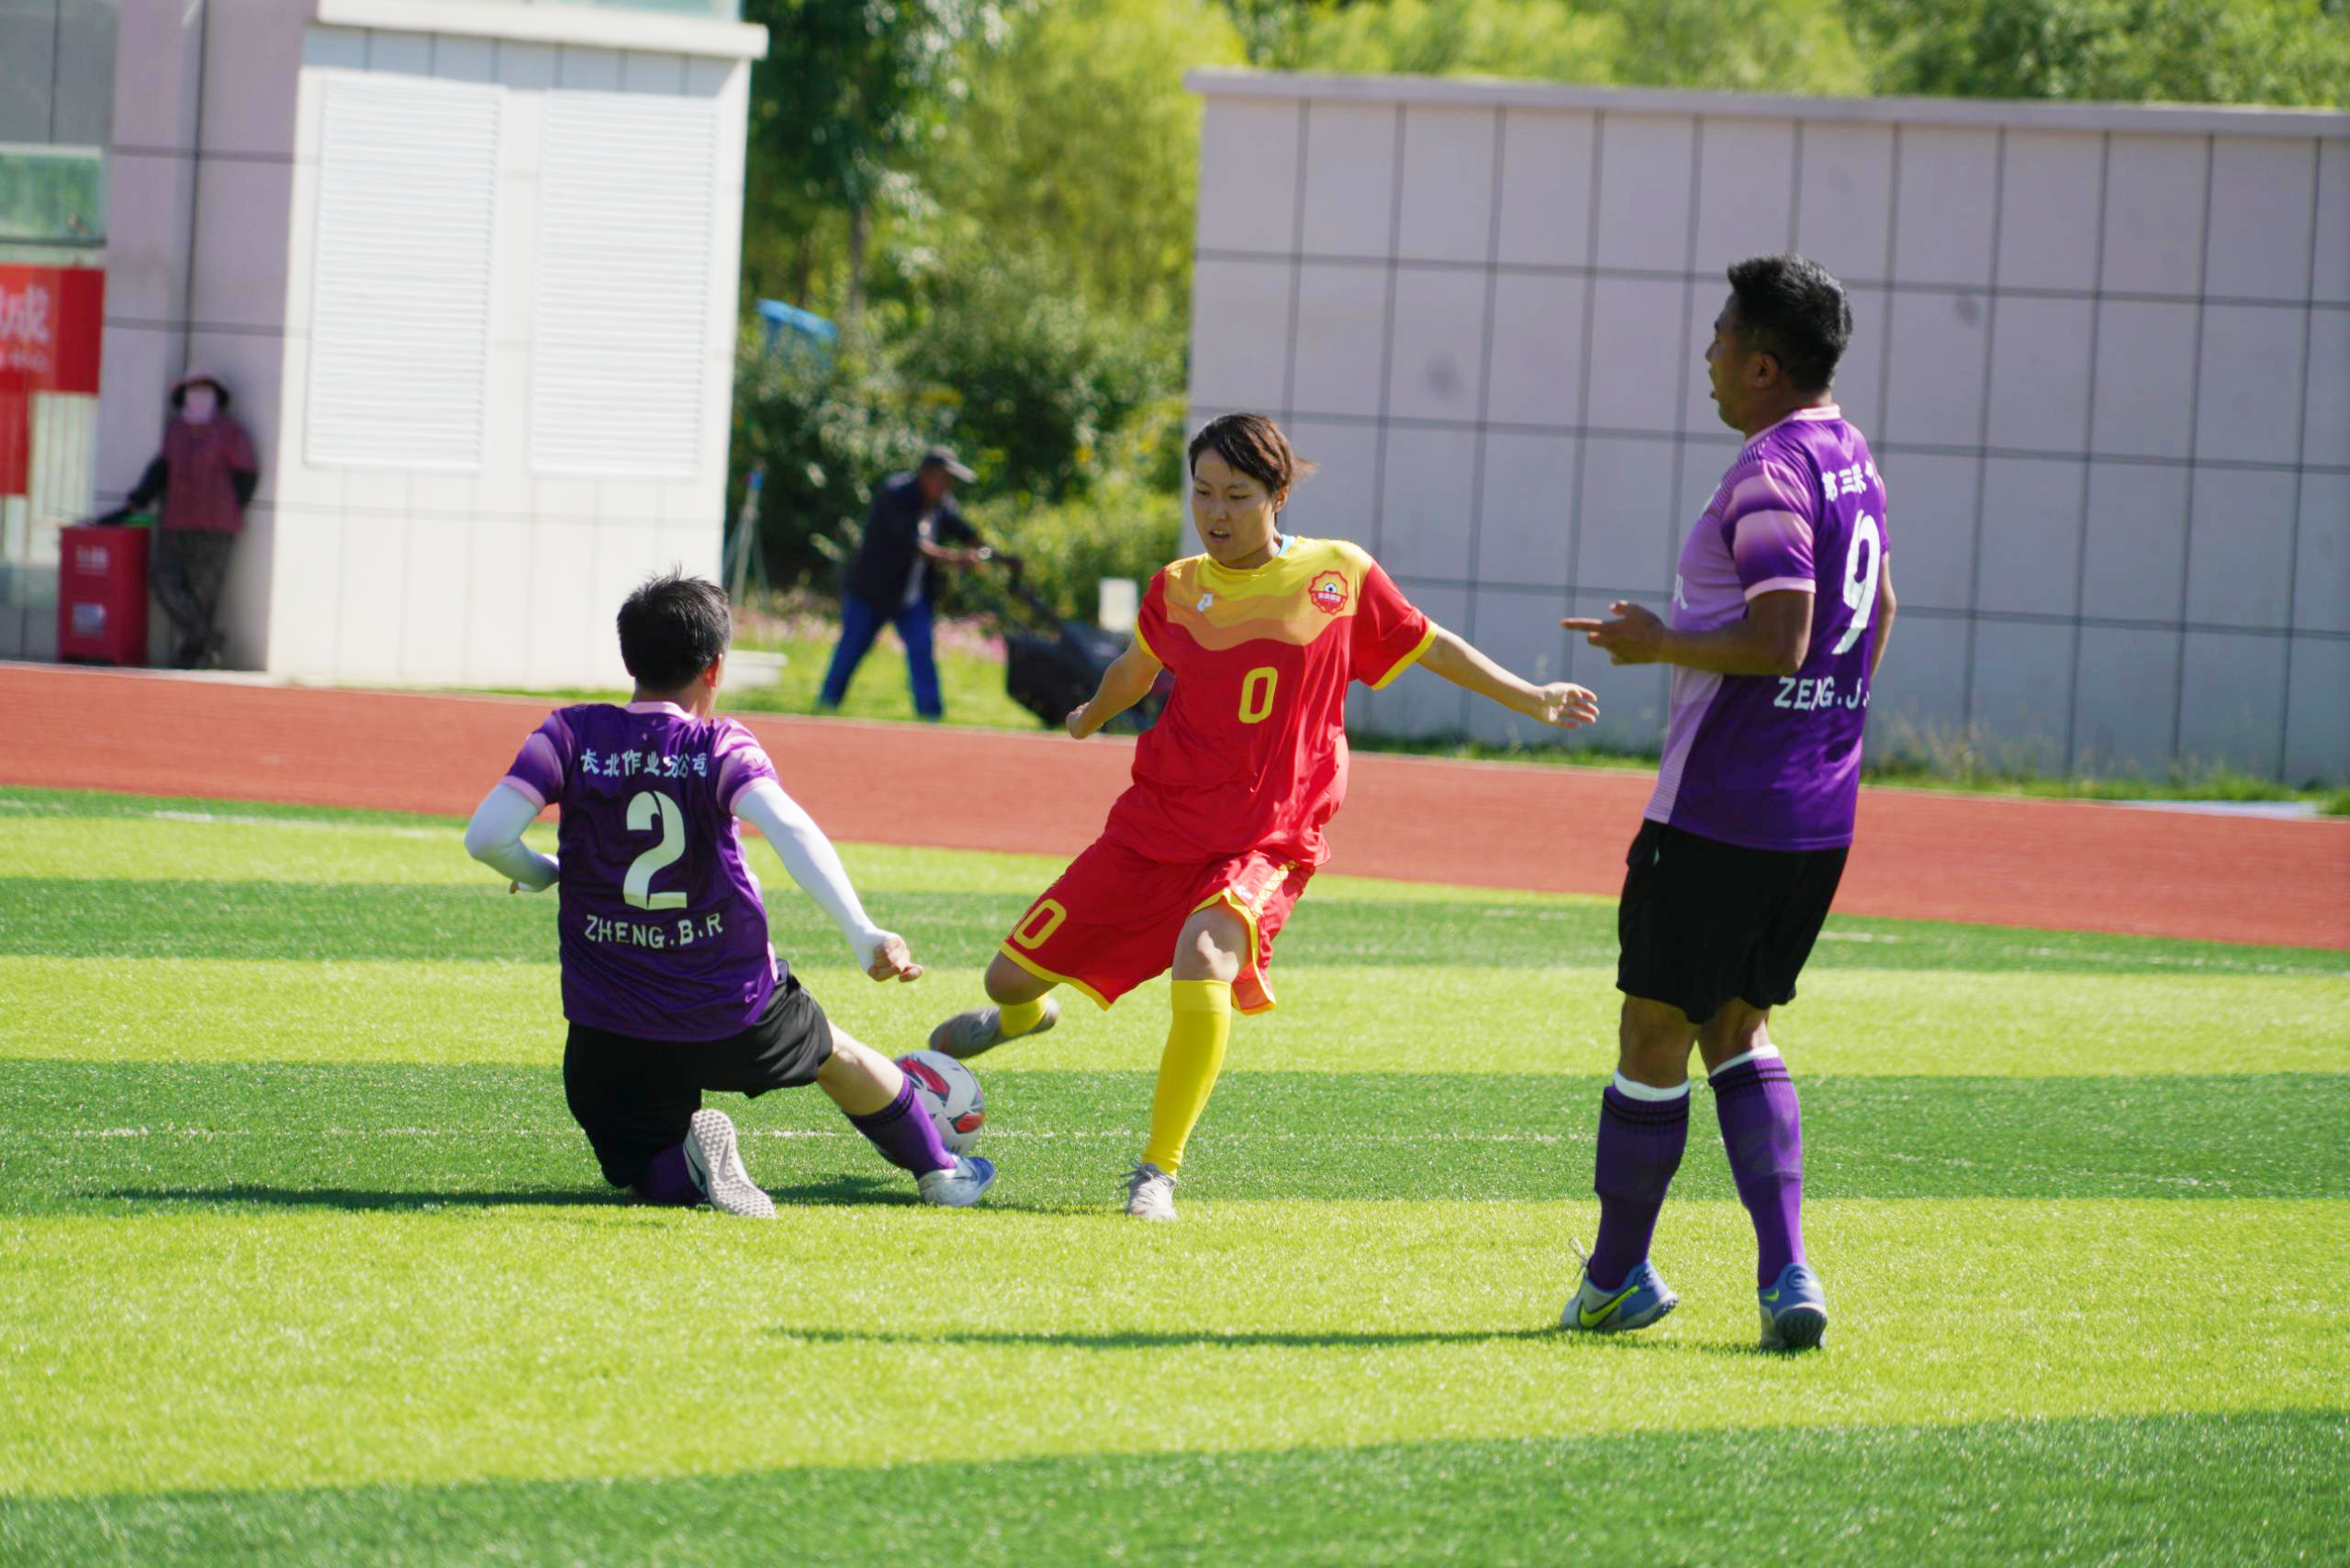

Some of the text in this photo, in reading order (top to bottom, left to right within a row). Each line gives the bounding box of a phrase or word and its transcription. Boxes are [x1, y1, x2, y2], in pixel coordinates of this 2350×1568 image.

[1831, 509, 1880, 655] 9
[1238, 666, 1278, 723] 0
[580, 748, 708, 778] 长北作业分公司
[622, 790, 688, 911] 2
[584, 913, 723, 948] ZHENG.B.R
[1013, 899, 1067, 950] 0
